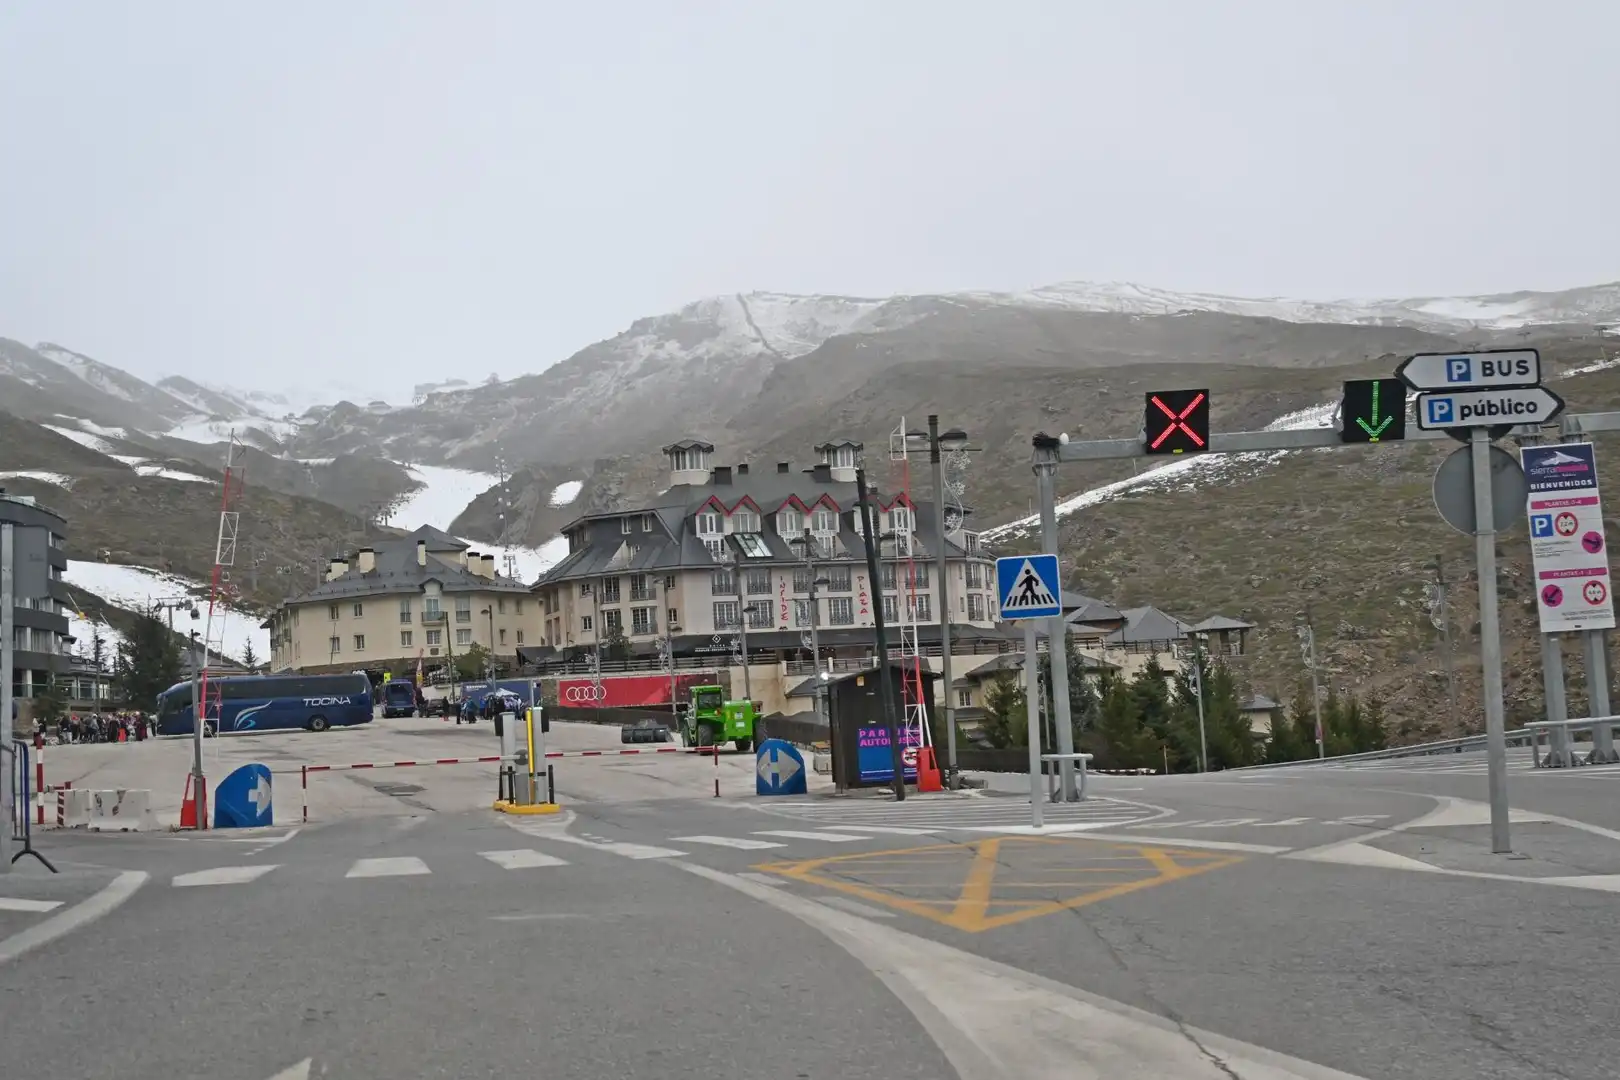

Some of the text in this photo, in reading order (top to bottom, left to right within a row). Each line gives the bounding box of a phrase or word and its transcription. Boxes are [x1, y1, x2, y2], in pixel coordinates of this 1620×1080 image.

[1450, 359, 1530, 381] P BUS
[1433, 399, 1538, 421] P público
[1530, 479, 1593, 490] BIENVENIDOS
[1534, 517, 1548, 535] P
[303, 696, 351, 707] TOCINA
